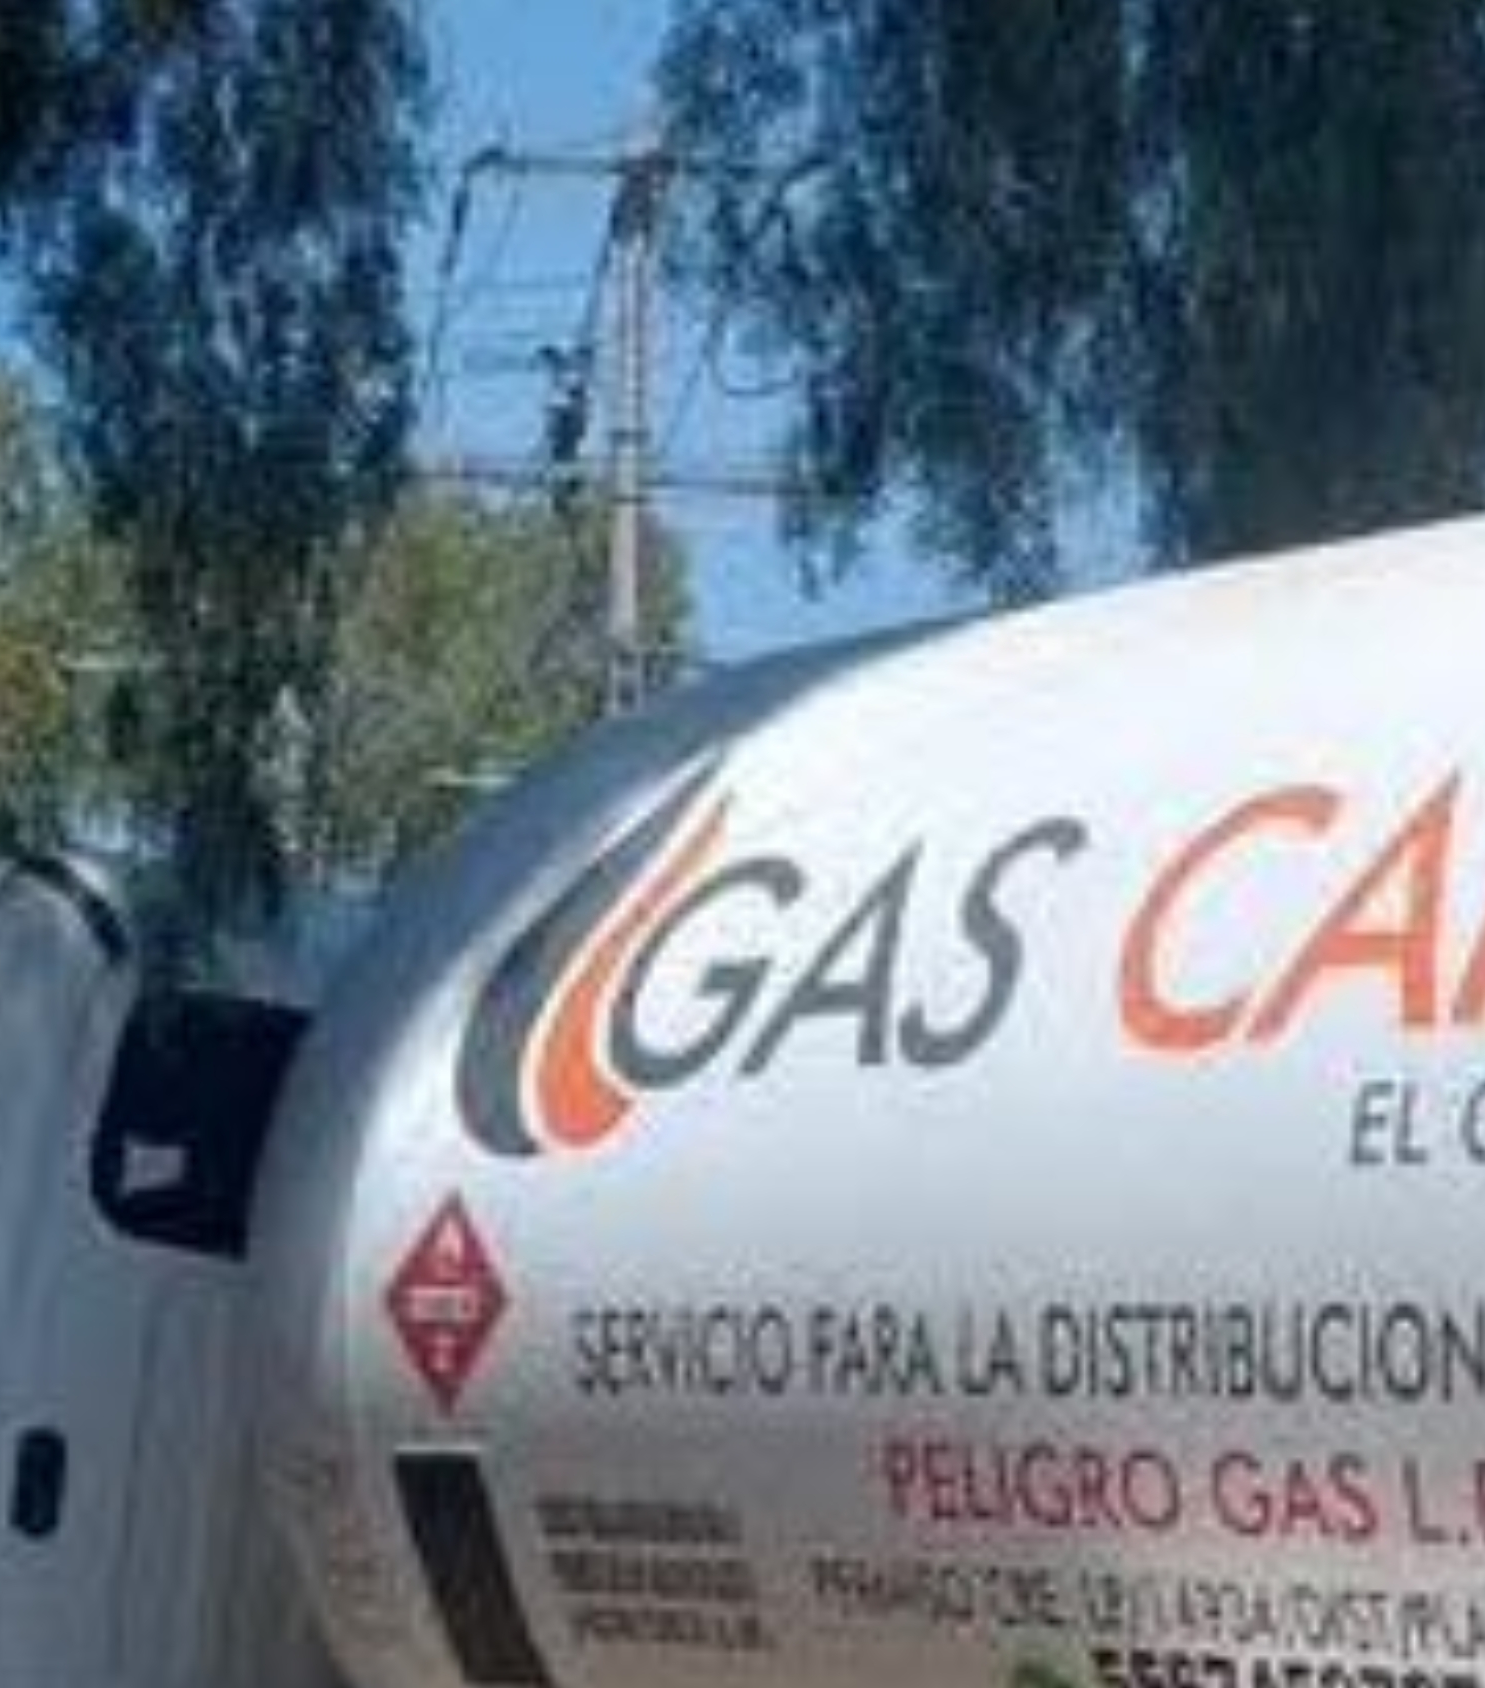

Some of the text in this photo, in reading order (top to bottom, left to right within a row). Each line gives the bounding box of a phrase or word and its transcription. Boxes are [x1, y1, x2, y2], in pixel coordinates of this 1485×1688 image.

[609, 817, 1087, 1090] GAS
[1349, 1081, 1428, 1166] EL
[573, 1307, 792, 1398] SERVICIO
[810, 1307, 943, 1398] PARA
[957, 1308, 1023, 1397] LA
[881, 1438, 1183, 1532] PELIGRO
[1211, 1452, 1379, 1544] GAS
